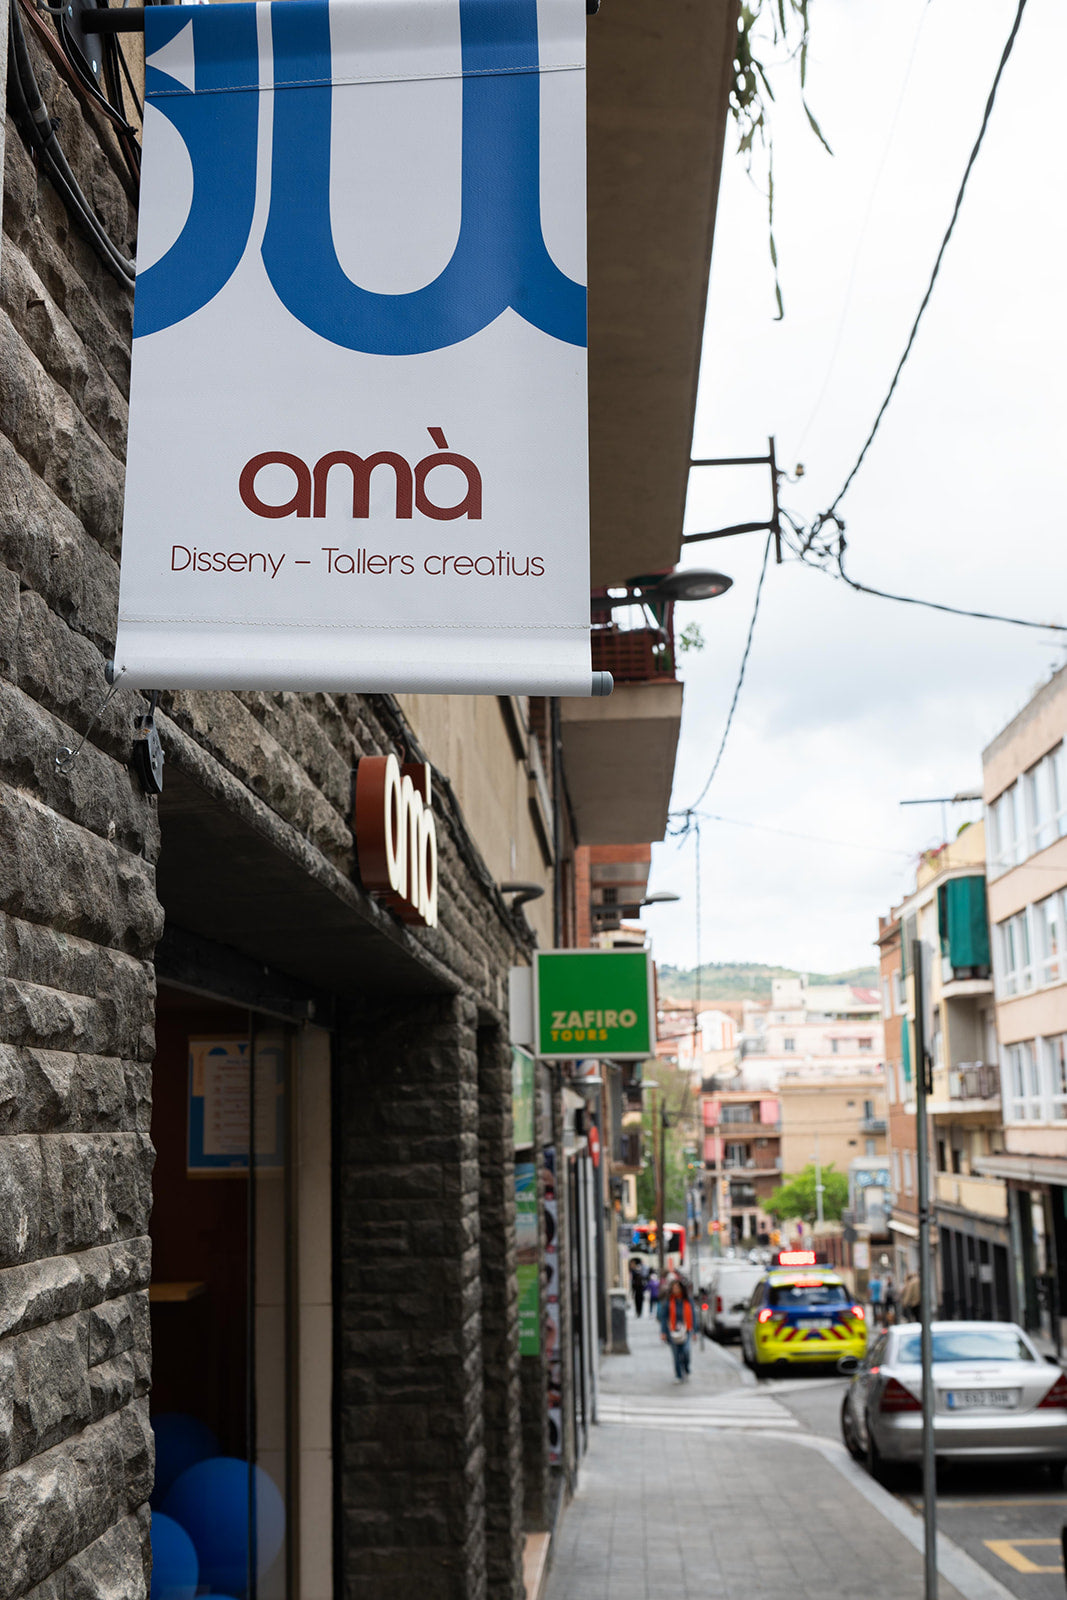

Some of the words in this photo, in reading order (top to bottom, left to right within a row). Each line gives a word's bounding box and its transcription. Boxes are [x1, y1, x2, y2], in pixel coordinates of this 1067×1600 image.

[239, 427, 482, 521] amà
[171, 545, 286, 580] Disseny
[320, 547, 415, 575] Tallers
[423, 550, 545, 577] creatius
[551, 1009, 638, 1028] ZAFIRO
[551, 1029, 608, 1042] TOURS
